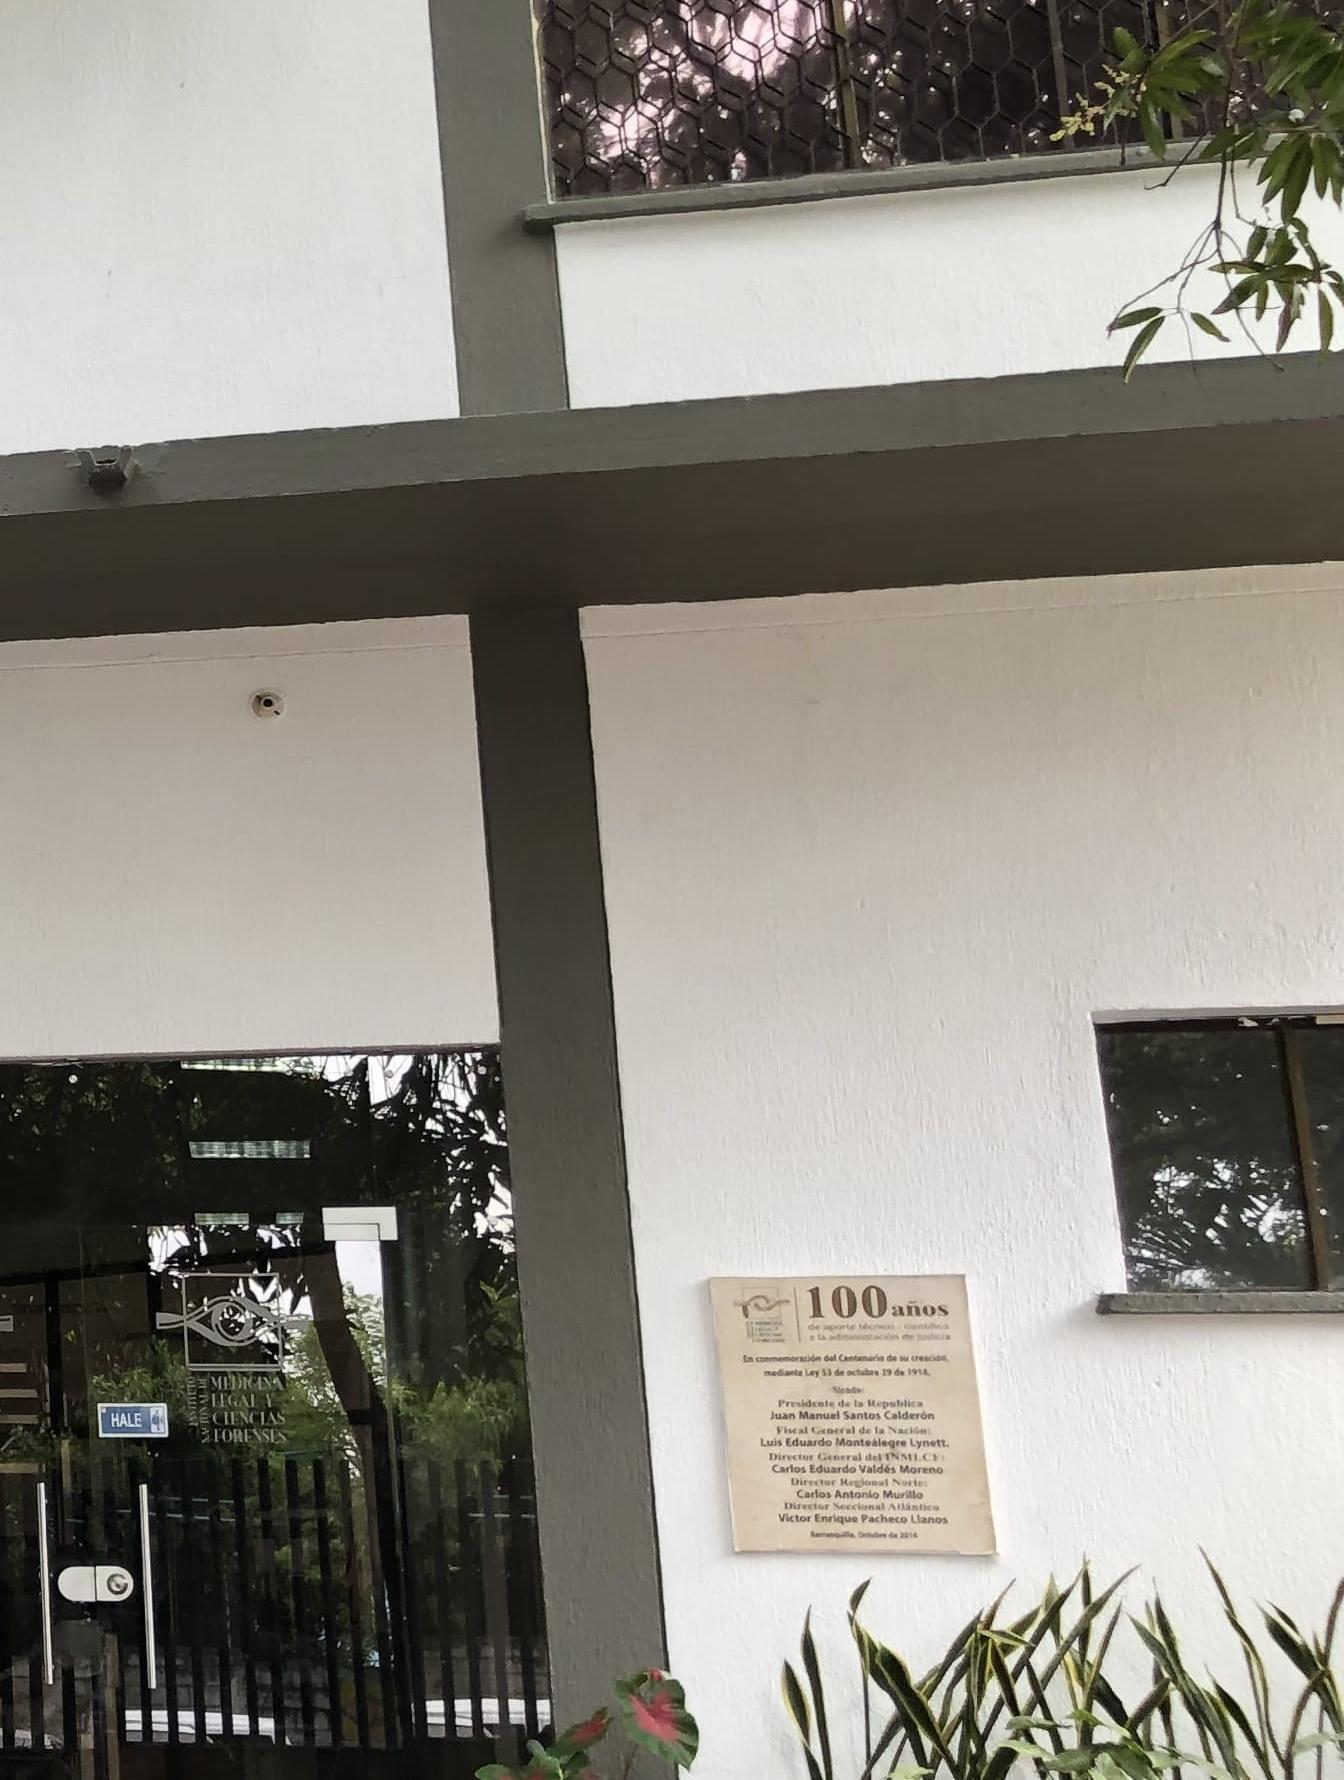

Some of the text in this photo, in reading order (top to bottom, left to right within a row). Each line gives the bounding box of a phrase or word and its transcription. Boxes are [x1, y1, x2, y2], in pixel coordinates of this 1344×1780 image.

[807, 1285, 949, 1319] 100 años
[211, 1376, 284, 1391] MEDICINA
[211, 1393, 258, 1408] LEGAL
[778, 1399, 834, 1408] Presidente
[838, 1399, 851, 1408] de
[111, 1412, 143, 1428] HALE
[212, 1411, 286, 1426] CIENCIAS
[770, 1411, 935, 1420] Juan Manuel Santos Calderón
[213, 1428, 287, 1443] FORENSES
[776, 1426, 808, 1435] Fiscal
[811, 1426, 855, 1435] General
[859, 1426, 871, 1435] de
[875, 1426, 885, 1435] la
[760, 1438, 782, 1447] Luis
[786, 1438, 832, 1447] Eduardo
[769, 1453, 813, 1461] Director
[817, 1453, 861, 1461] General
[771, 1464, 943, 1474] Carlos Eduardo Valdés Moreno
[791, 1478, 835, 1486] Director
[840, 1478, 888, 1488] Regional
[796, 1490, 923, 1499] Carlos Antonio Murillo
[784, 1502, 829, 1510] Director
[833, 1502, 885, 1510] Seccional
[815, 1514, 858, 1525] Enrique
[861, 1514, 907, 1524] Pacheco
[911, 1514, 948, 1524] Llanos
